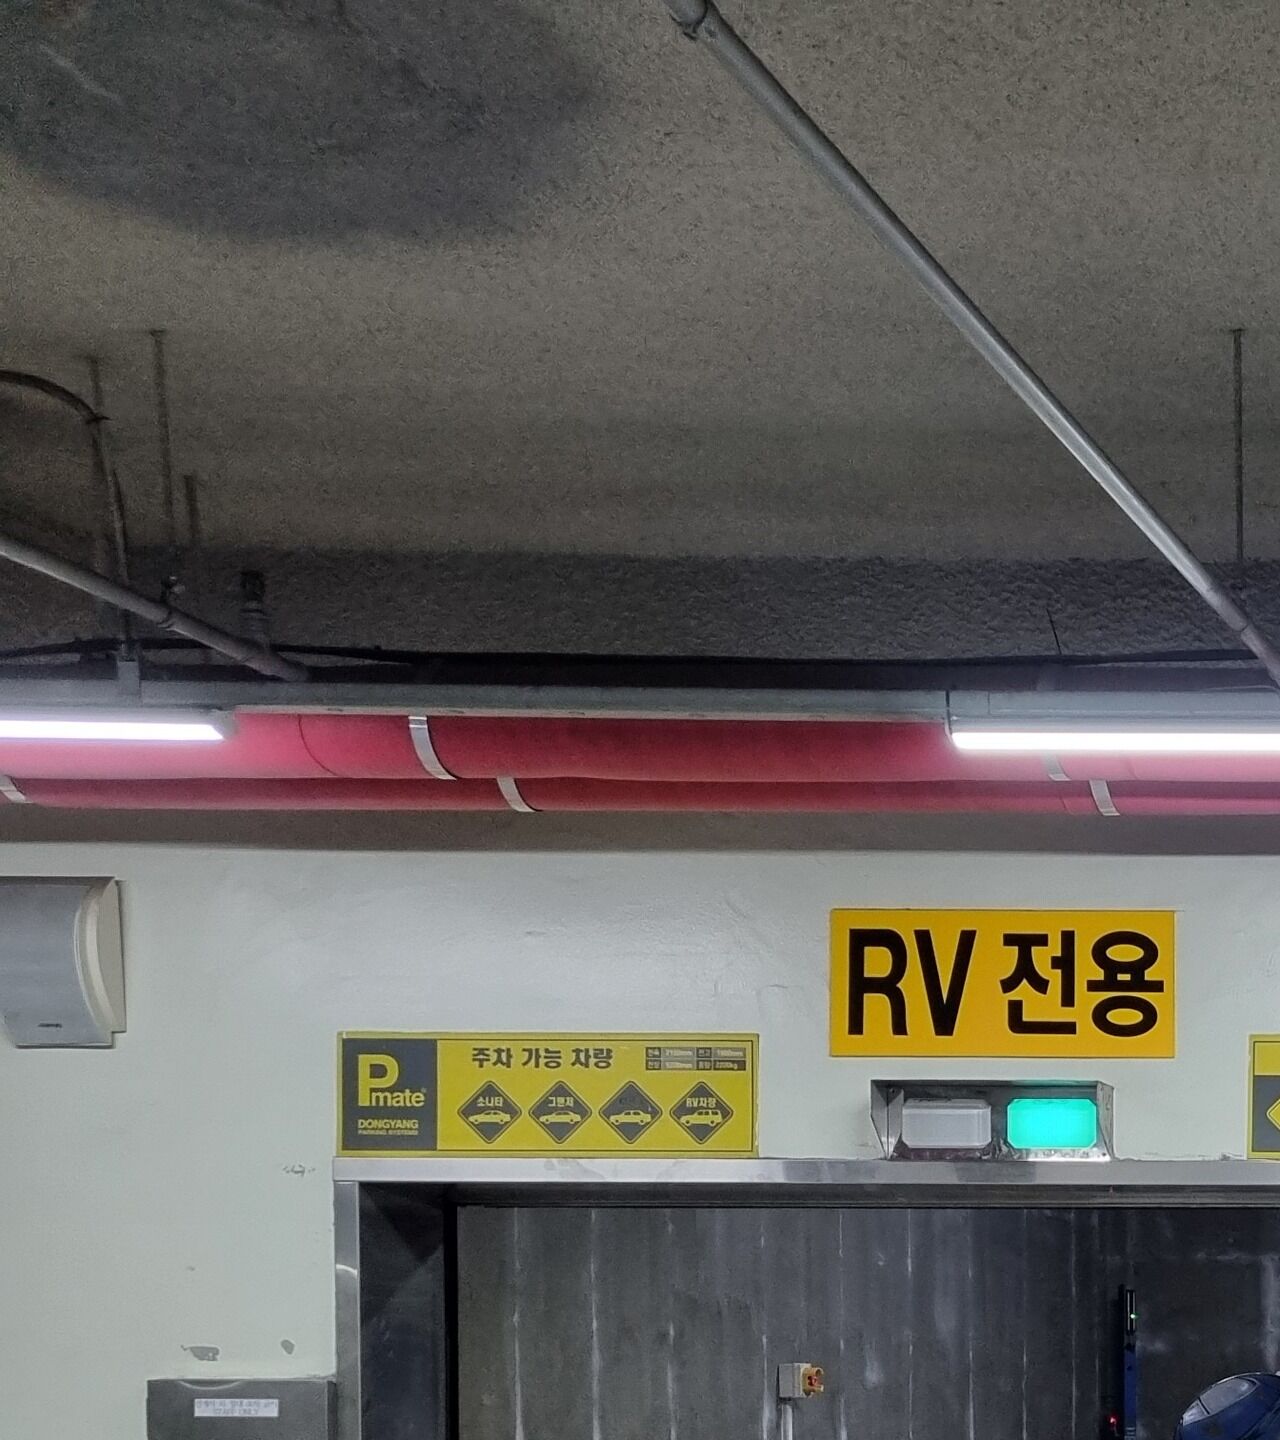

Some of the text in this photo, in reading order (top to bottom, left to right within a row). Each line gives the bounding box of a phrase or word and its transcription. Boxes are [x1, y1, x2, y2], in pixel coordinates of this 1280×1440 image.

[848, 929, 1164, 1036] RV 전용
[472, 1047, 613, 1069] 주차 가능 차량
[358, 1054, 425, 1107] Pmate
[686, 1097, 716, 1107] RV차량
[358, 1119, 419, 1129] DONGYANG
